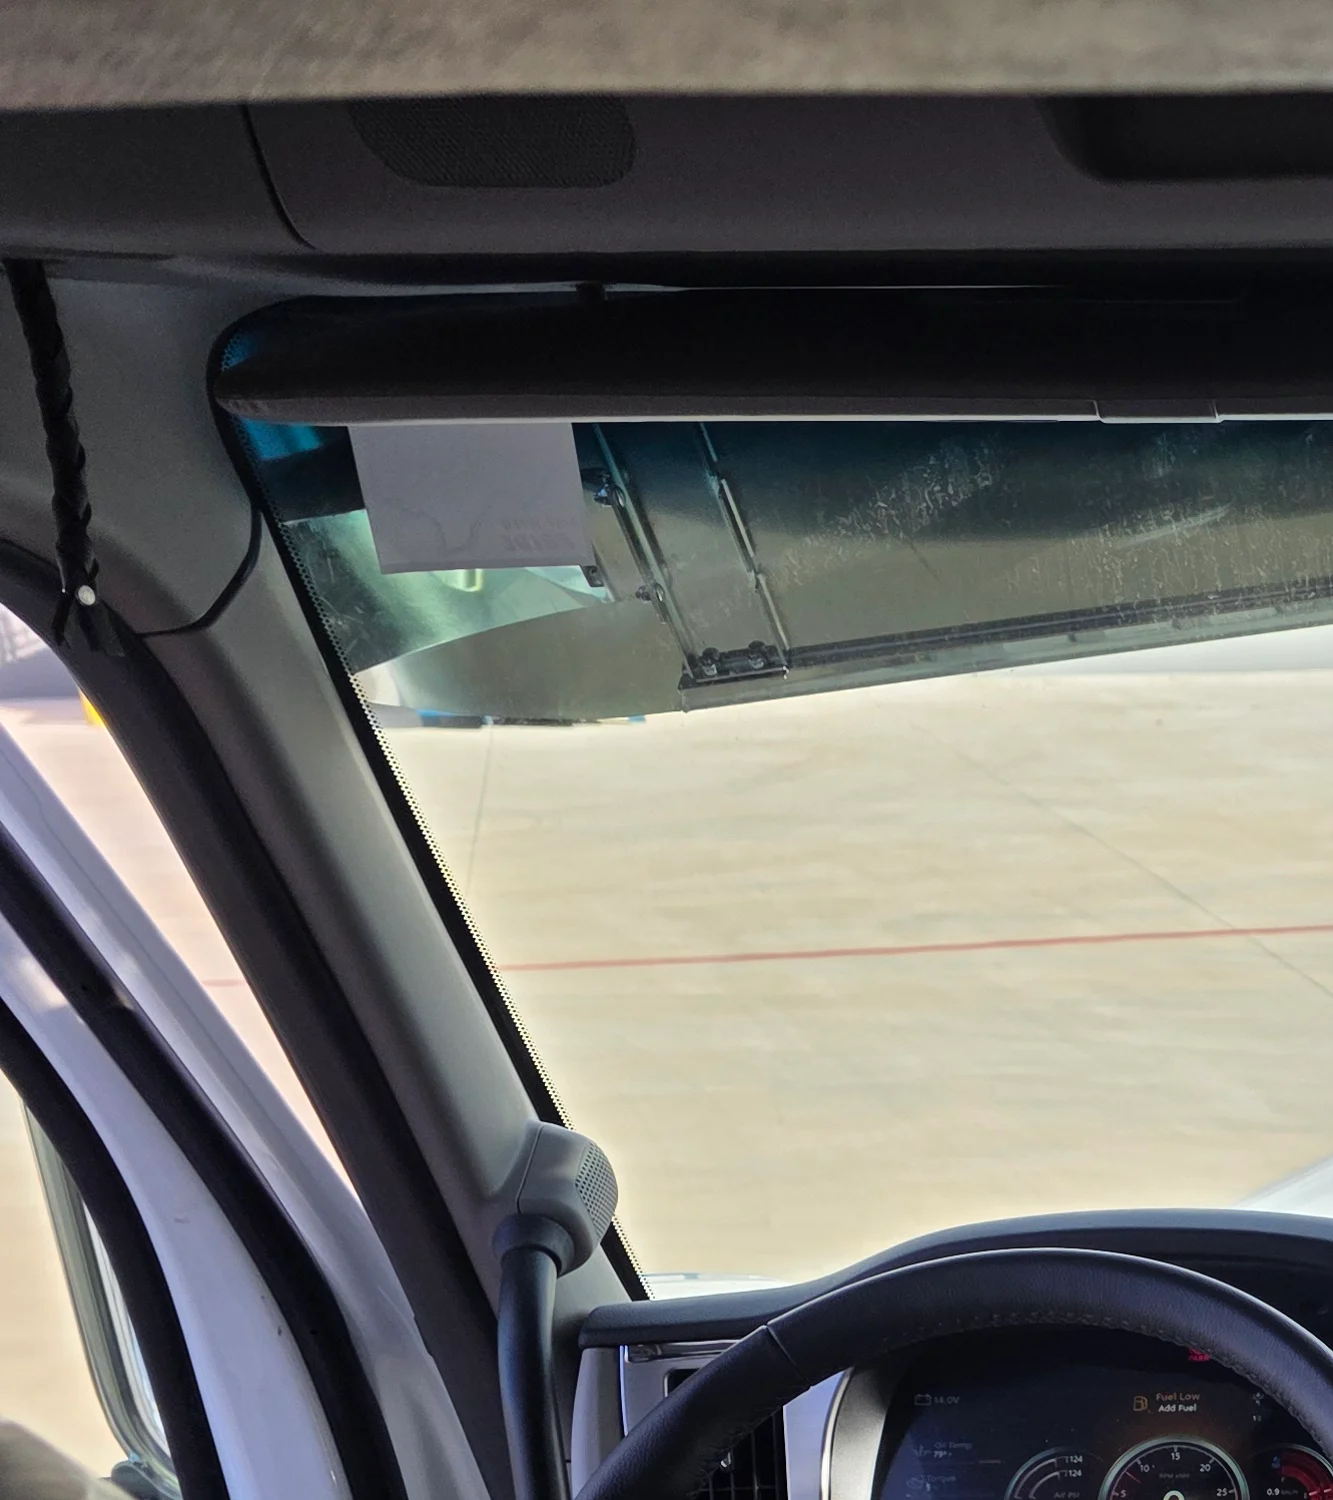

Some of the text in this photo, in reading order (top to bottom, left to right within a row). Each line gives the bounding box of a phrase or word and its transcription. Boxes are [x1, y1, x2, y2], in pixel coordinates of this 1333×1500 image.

[1155, 1392, 1201, 1401] Fuel Low
[1158, 1403, 1197, 1413] Add Fuel
[1070, 1455, 1084, 1464] 124
[1170, 1451, 1181, 1461] 15
[1140, 1464, 1152, 1473] 10
[1200, 1463, 1212, 1473] 20
[1068, 1469, 1082, 1478] 124
[1120, 1489, 1127, 1498] 5
[1216, 1488, 1229, 1498] 25
[1266, 1487, 1280, 1496] 0.9
